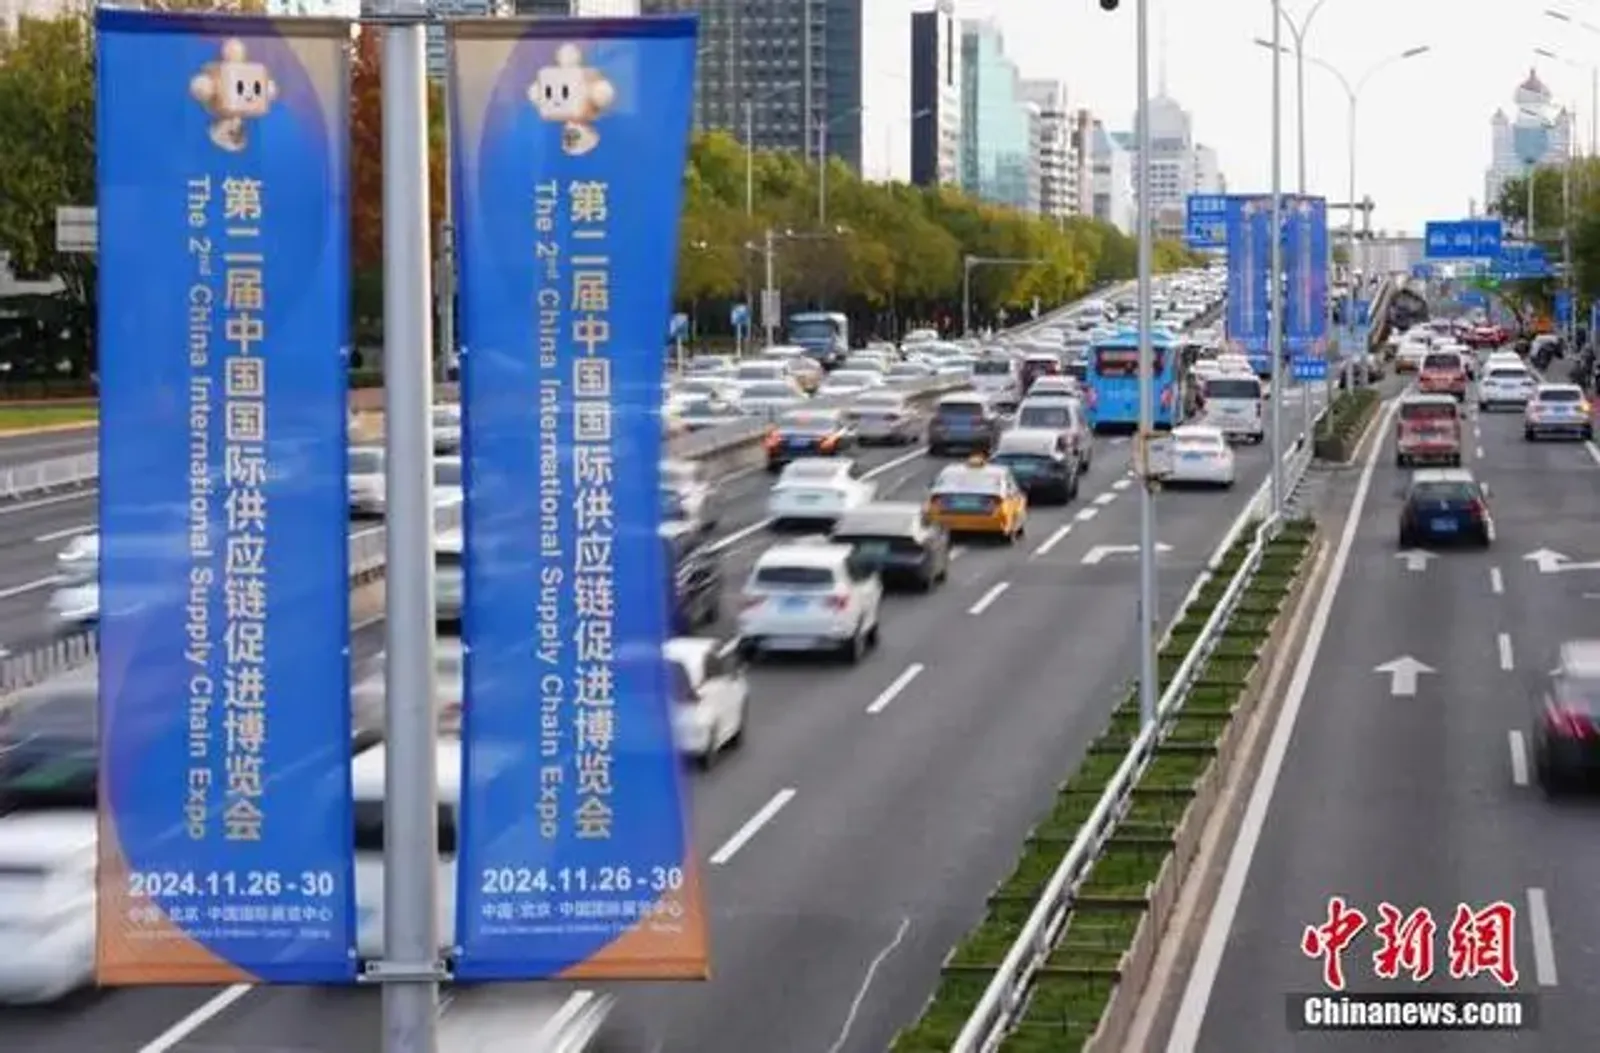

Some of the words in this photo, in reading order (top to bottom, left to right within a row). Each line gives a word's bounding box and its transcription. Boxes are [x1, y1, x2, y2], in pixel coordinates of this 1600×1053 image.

[187, 173, 211, 228] The
[534, 179, 558, 232] The
[189, 284, 213, 367] China
[538, 288, 562, 369] China
[189, 376, 214, 557] International
[539, 378, 563, 557] International
[222, 176, 267, 841] 第二届中国国际供应链促进博览会
[568, 179, 615, 840] 第二届中国国际供应链促进博览会
[184, 566, 214, 667] Supply
[535, 566, 564, 665] Supply
[189, 675, 214, 757] Chain
[540, 673, 564, 757] Chain
[184, 767, 213, 840] Expo
[535, 765, 564, 839] Expo
